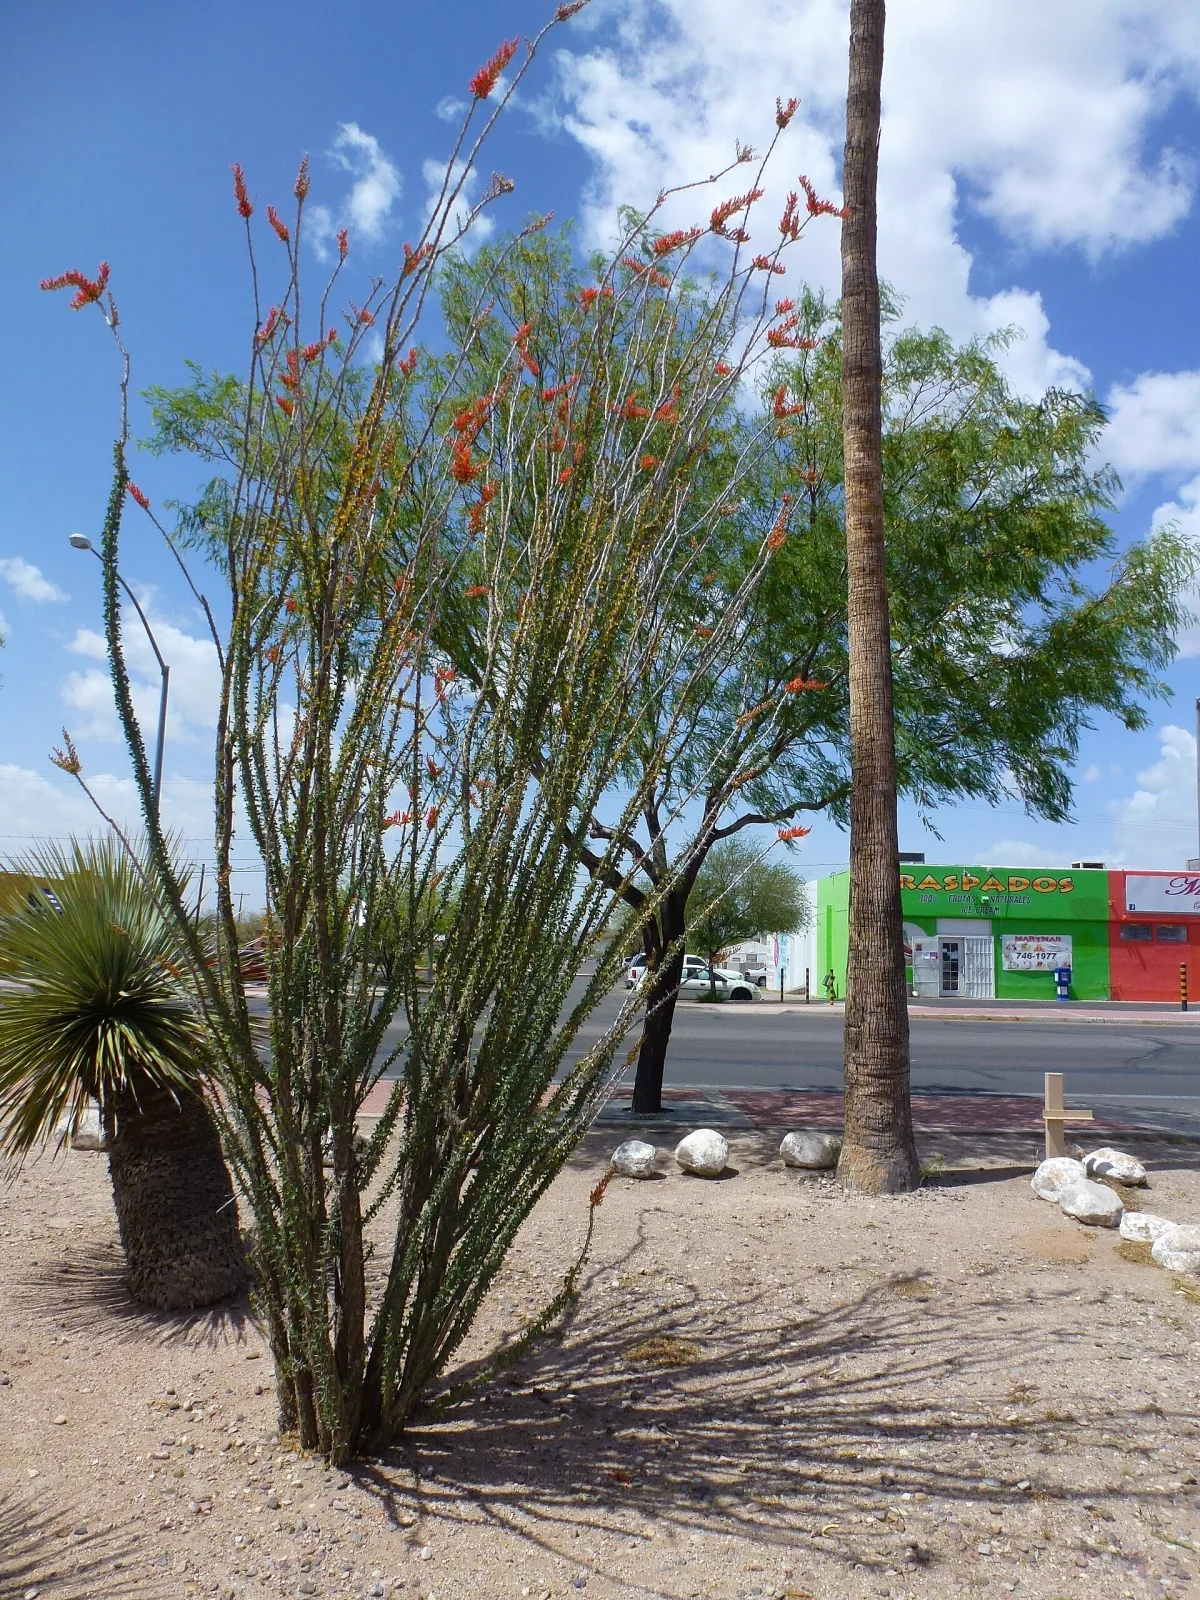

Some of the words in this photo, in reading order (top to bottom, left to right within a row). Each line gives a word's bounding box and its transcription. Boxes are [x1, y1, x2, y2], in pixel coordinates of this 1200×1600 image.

[900, 874, 1074, 894] RASPADOS
[948, 895, 976, 903] FRUTAS
[989, 896, 1032, 904] NATURALES
[961, 906, 972, 914] ICE
[975, 906, 1001, 915] CREAM
[1016, 952, 1057, 960] 746-1977
